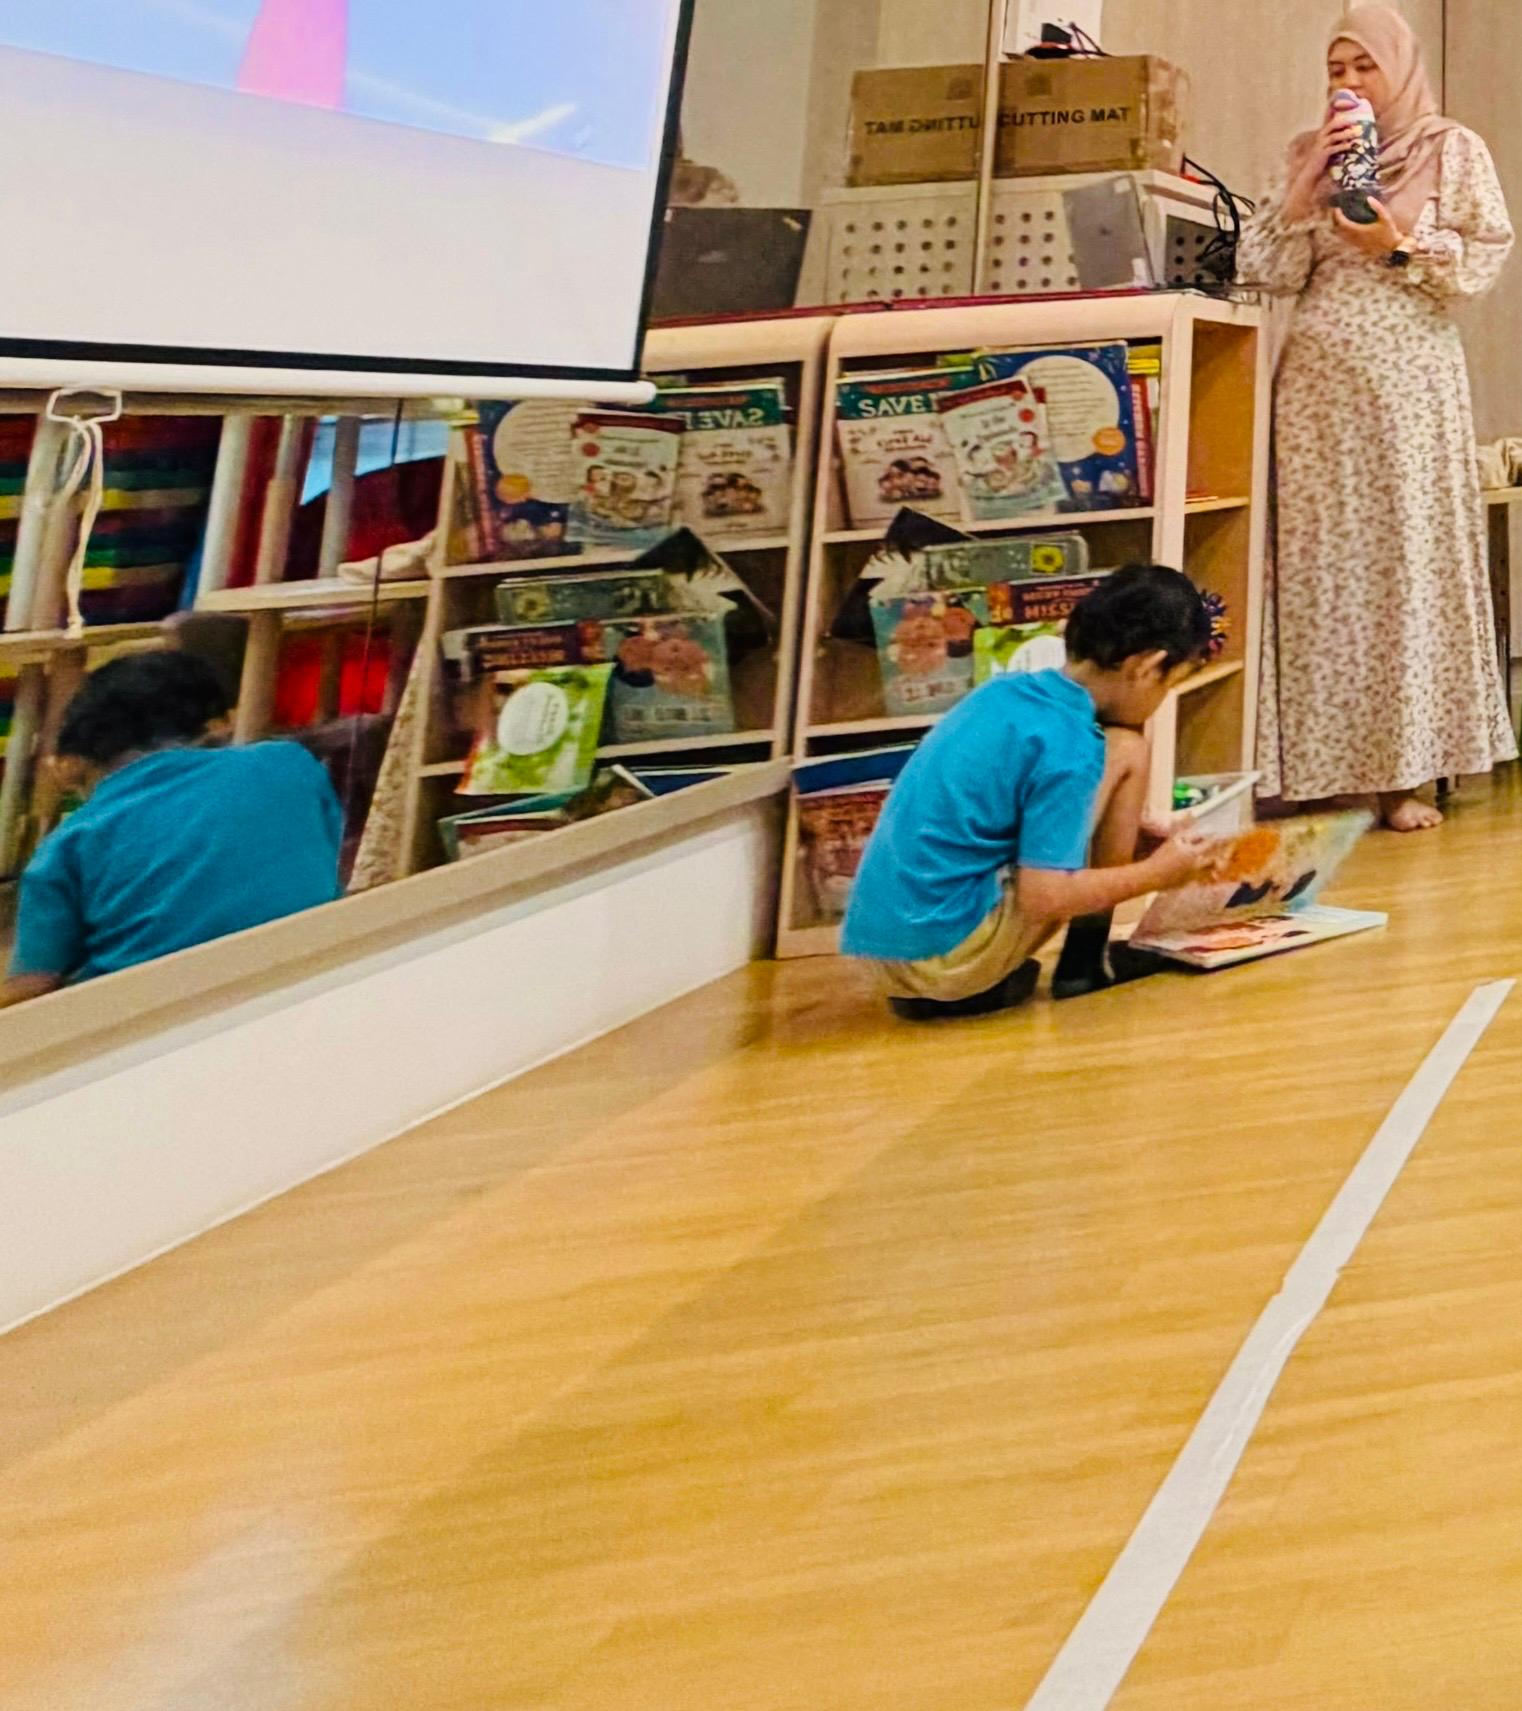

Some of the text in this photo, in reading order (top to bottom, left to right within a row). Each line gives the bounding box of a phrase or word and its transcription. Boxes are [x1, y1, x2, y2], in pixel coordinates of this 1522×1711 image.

[1000, 106, 1131, 129] CUTTING MAT
[858, 395, 926, 418] SAVE
